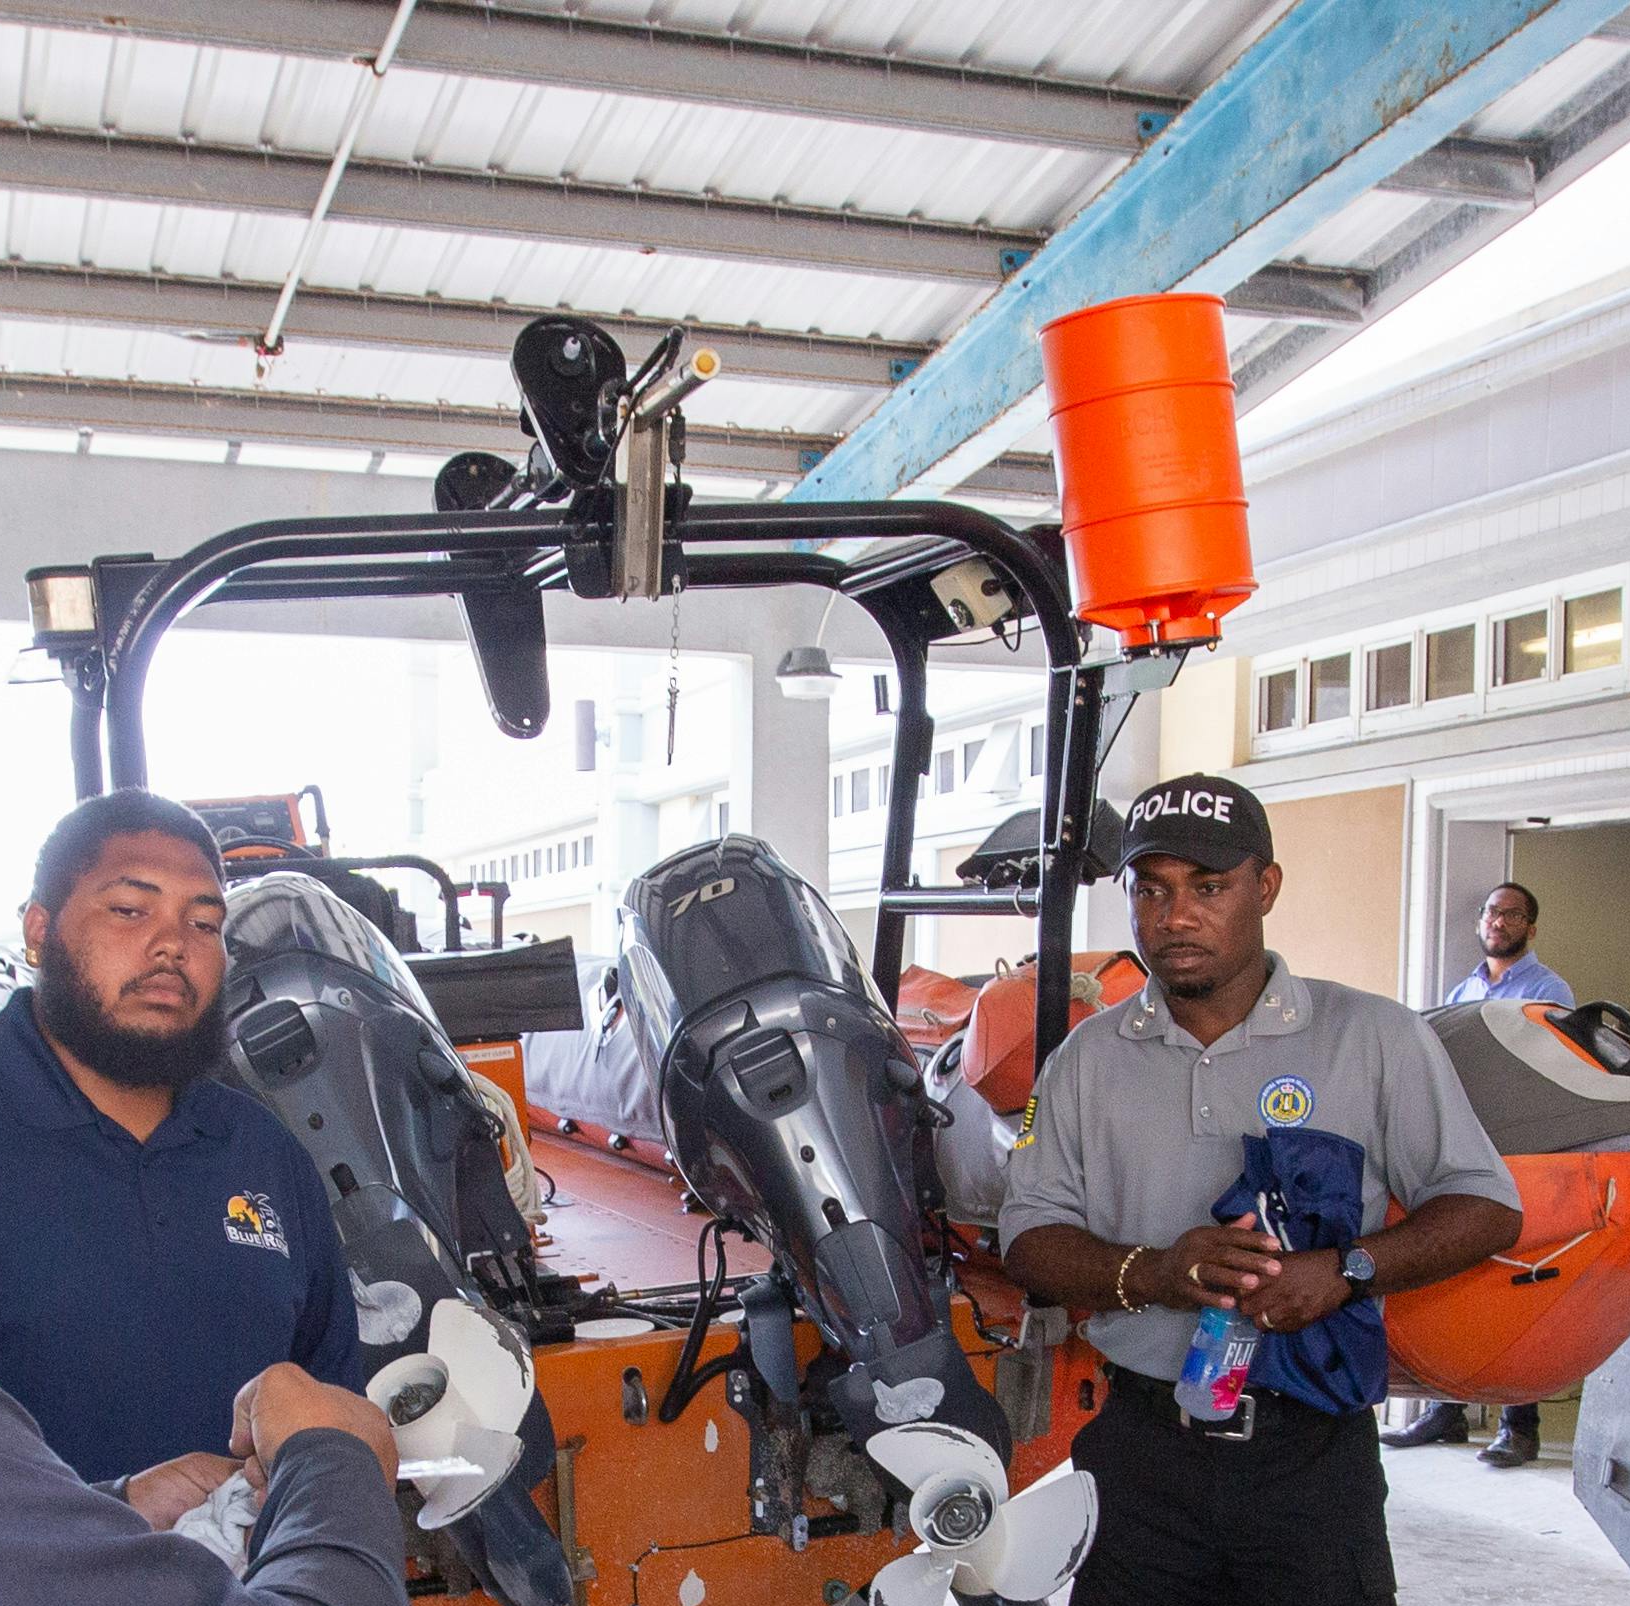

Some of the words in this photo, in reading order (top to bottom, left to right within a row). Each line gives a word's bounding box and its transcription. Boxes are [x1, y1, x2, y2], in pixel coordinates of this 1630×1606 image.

[1130, 790, 1234, 831] POLICE
[667, 877, 735, 918] 70
[1223, 1342, 1257, 1366] FIJI
